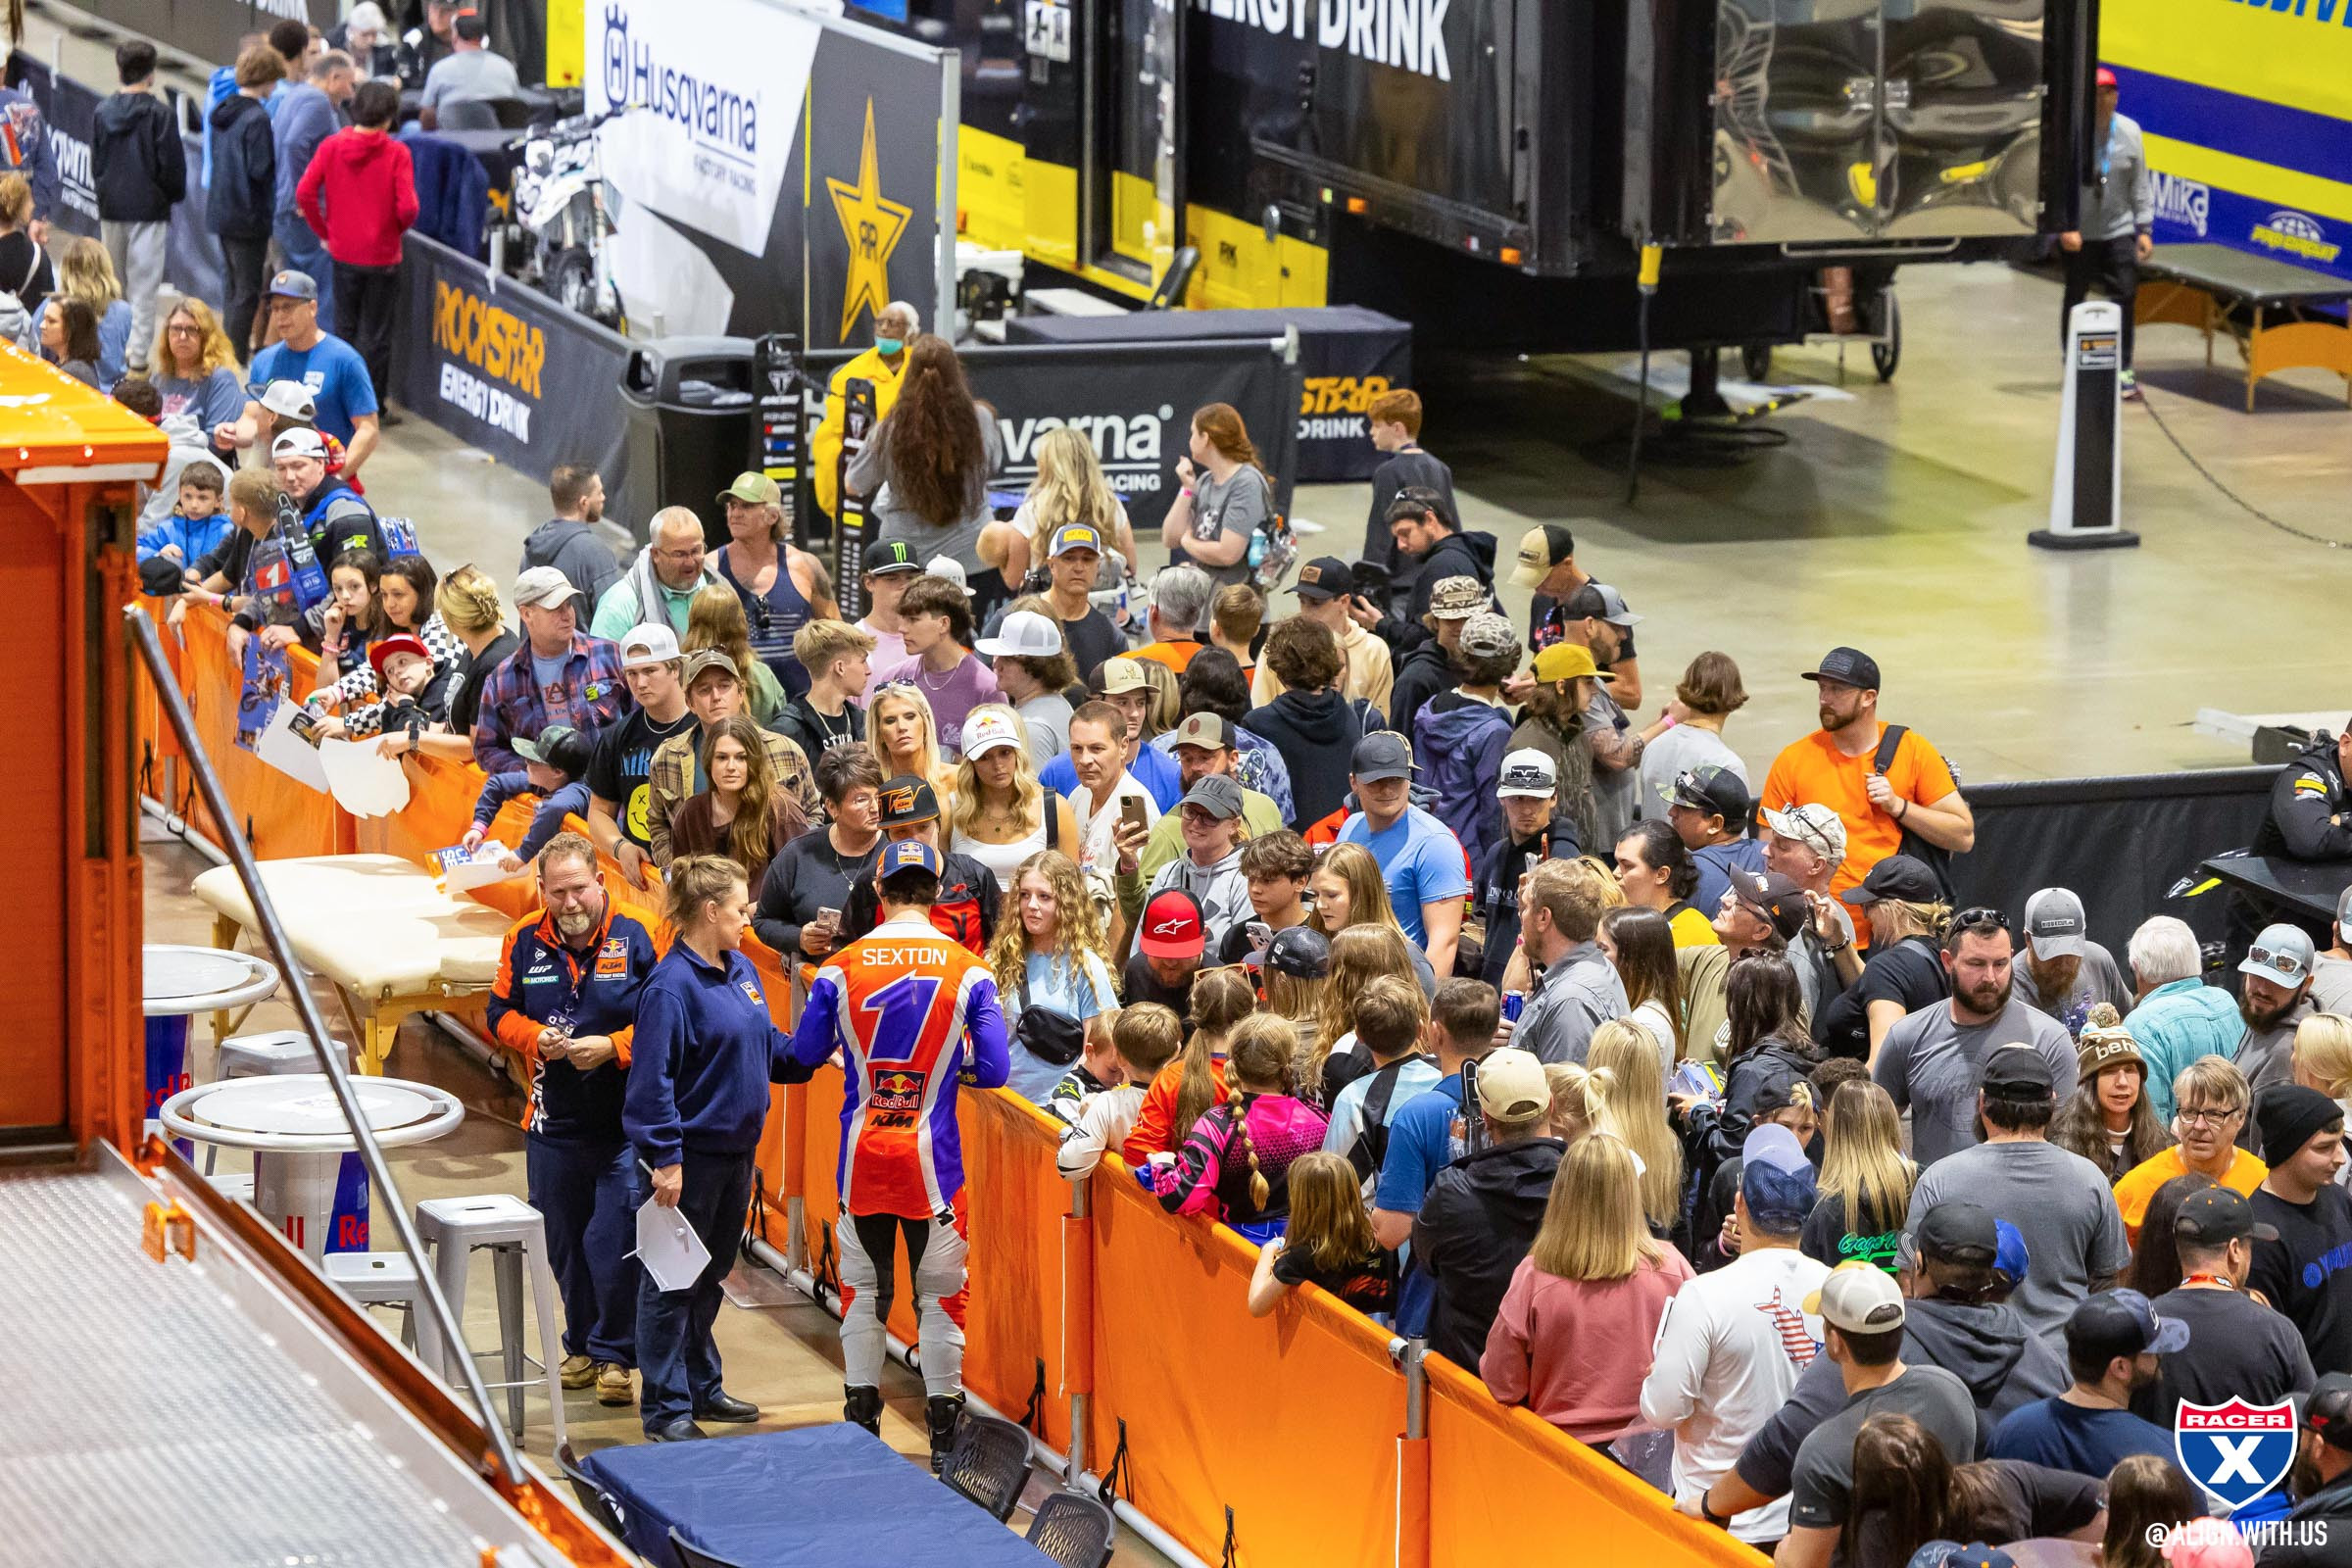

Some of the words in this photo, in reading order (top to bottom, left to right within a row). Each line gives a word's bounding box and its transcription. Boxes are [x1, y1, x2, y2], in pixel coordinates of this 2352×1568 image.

[634, 39, 756, 154] Husqvarna
[432, 279, 546, 400] ROCKSTAR
[440, 362, 488, 421] ENERGY
[488, 388, 531, 444] DRINK
[1299, 376, 1390, 415] STAR
[999, 414, 1161, 463] varna
[1107, 473, 1161, 491] ACING
[862, 948, 947, 965] SEXTON
[860, 969, 944, 1063] 1
[870, 1111, 914, 1128] KTM
[872, 1095, 896, 1108] Red
[895, 1095, 918, 1108] Bull
[339, 1215, 368, 1249] Re
